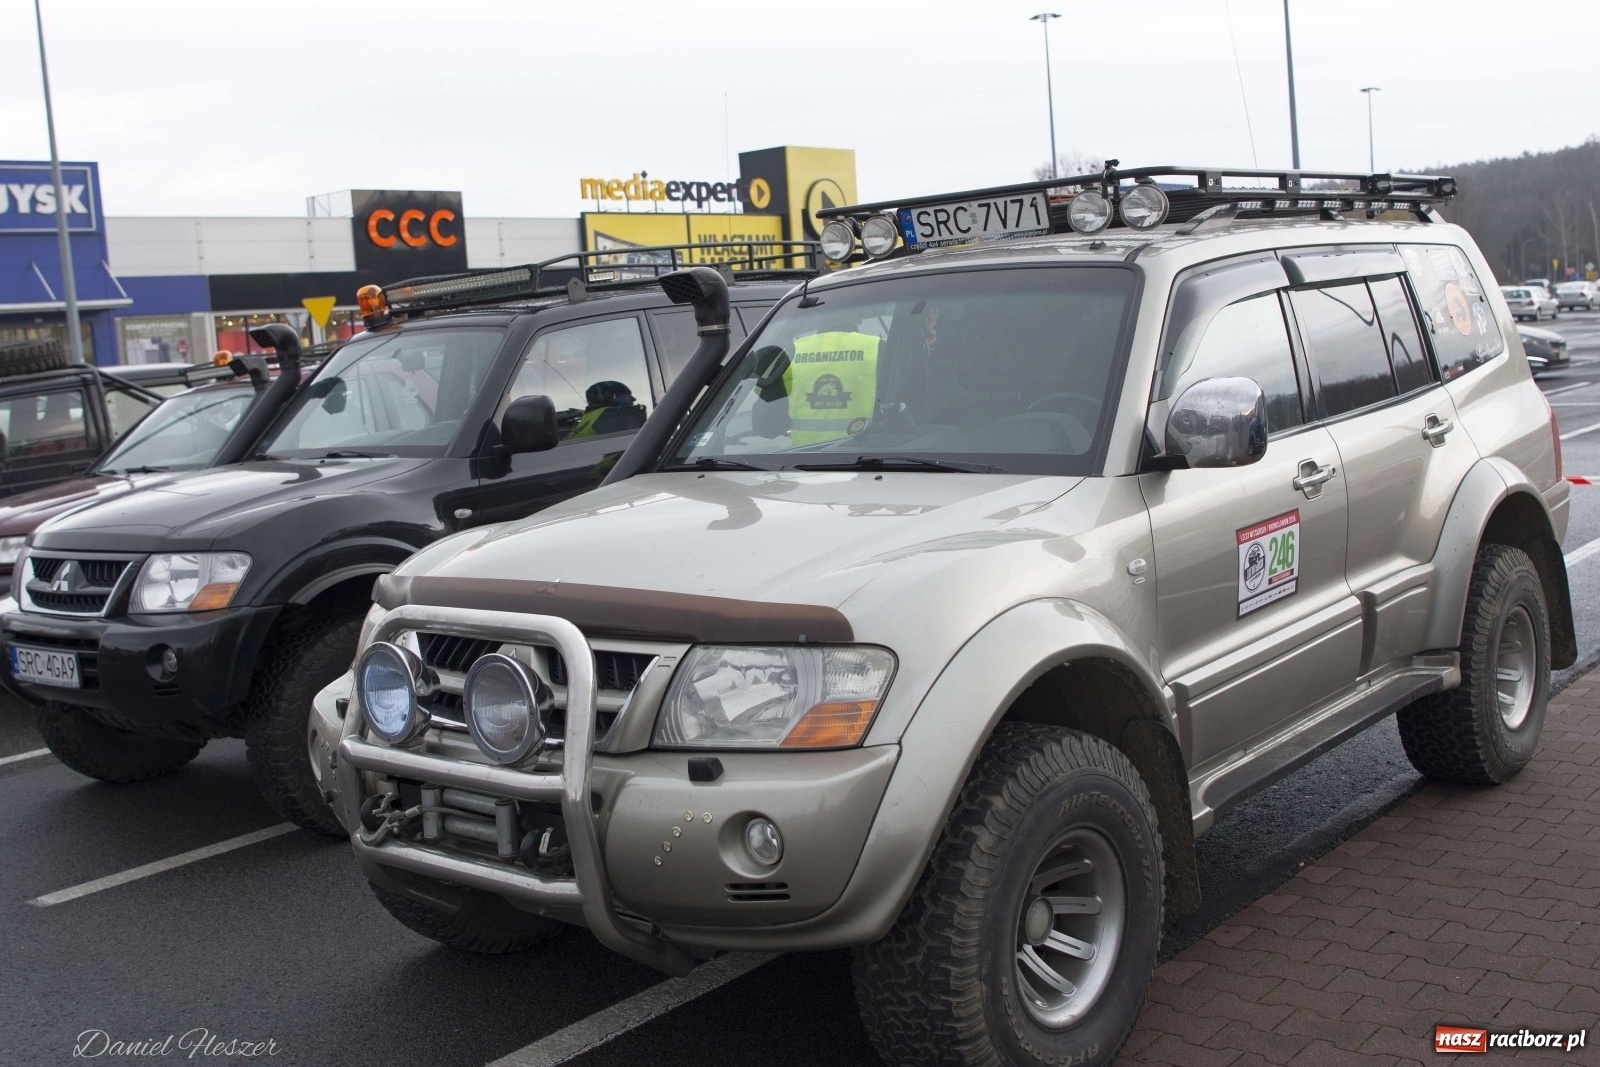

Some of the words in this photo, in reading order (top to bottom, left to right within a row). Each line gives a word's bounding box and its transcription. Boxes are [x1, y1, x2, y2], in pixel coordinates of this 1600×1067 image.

[0, 184, 88, 215] JYSK
[580, 170, 749, 209] mediaexpert
[367, 209, 457, 247] CCC
[905, 230, 915, 238] PL
[916, 206, 972, 238] SRC
[978, 196, 1041, 231] 7V71
[794, 350, 864, 364] ORGANIZATOR
[1268, 530, 1295, 577] 246
[19, 650, 43, 676] SRC
[46, 654, 75, 680] 4GA9
